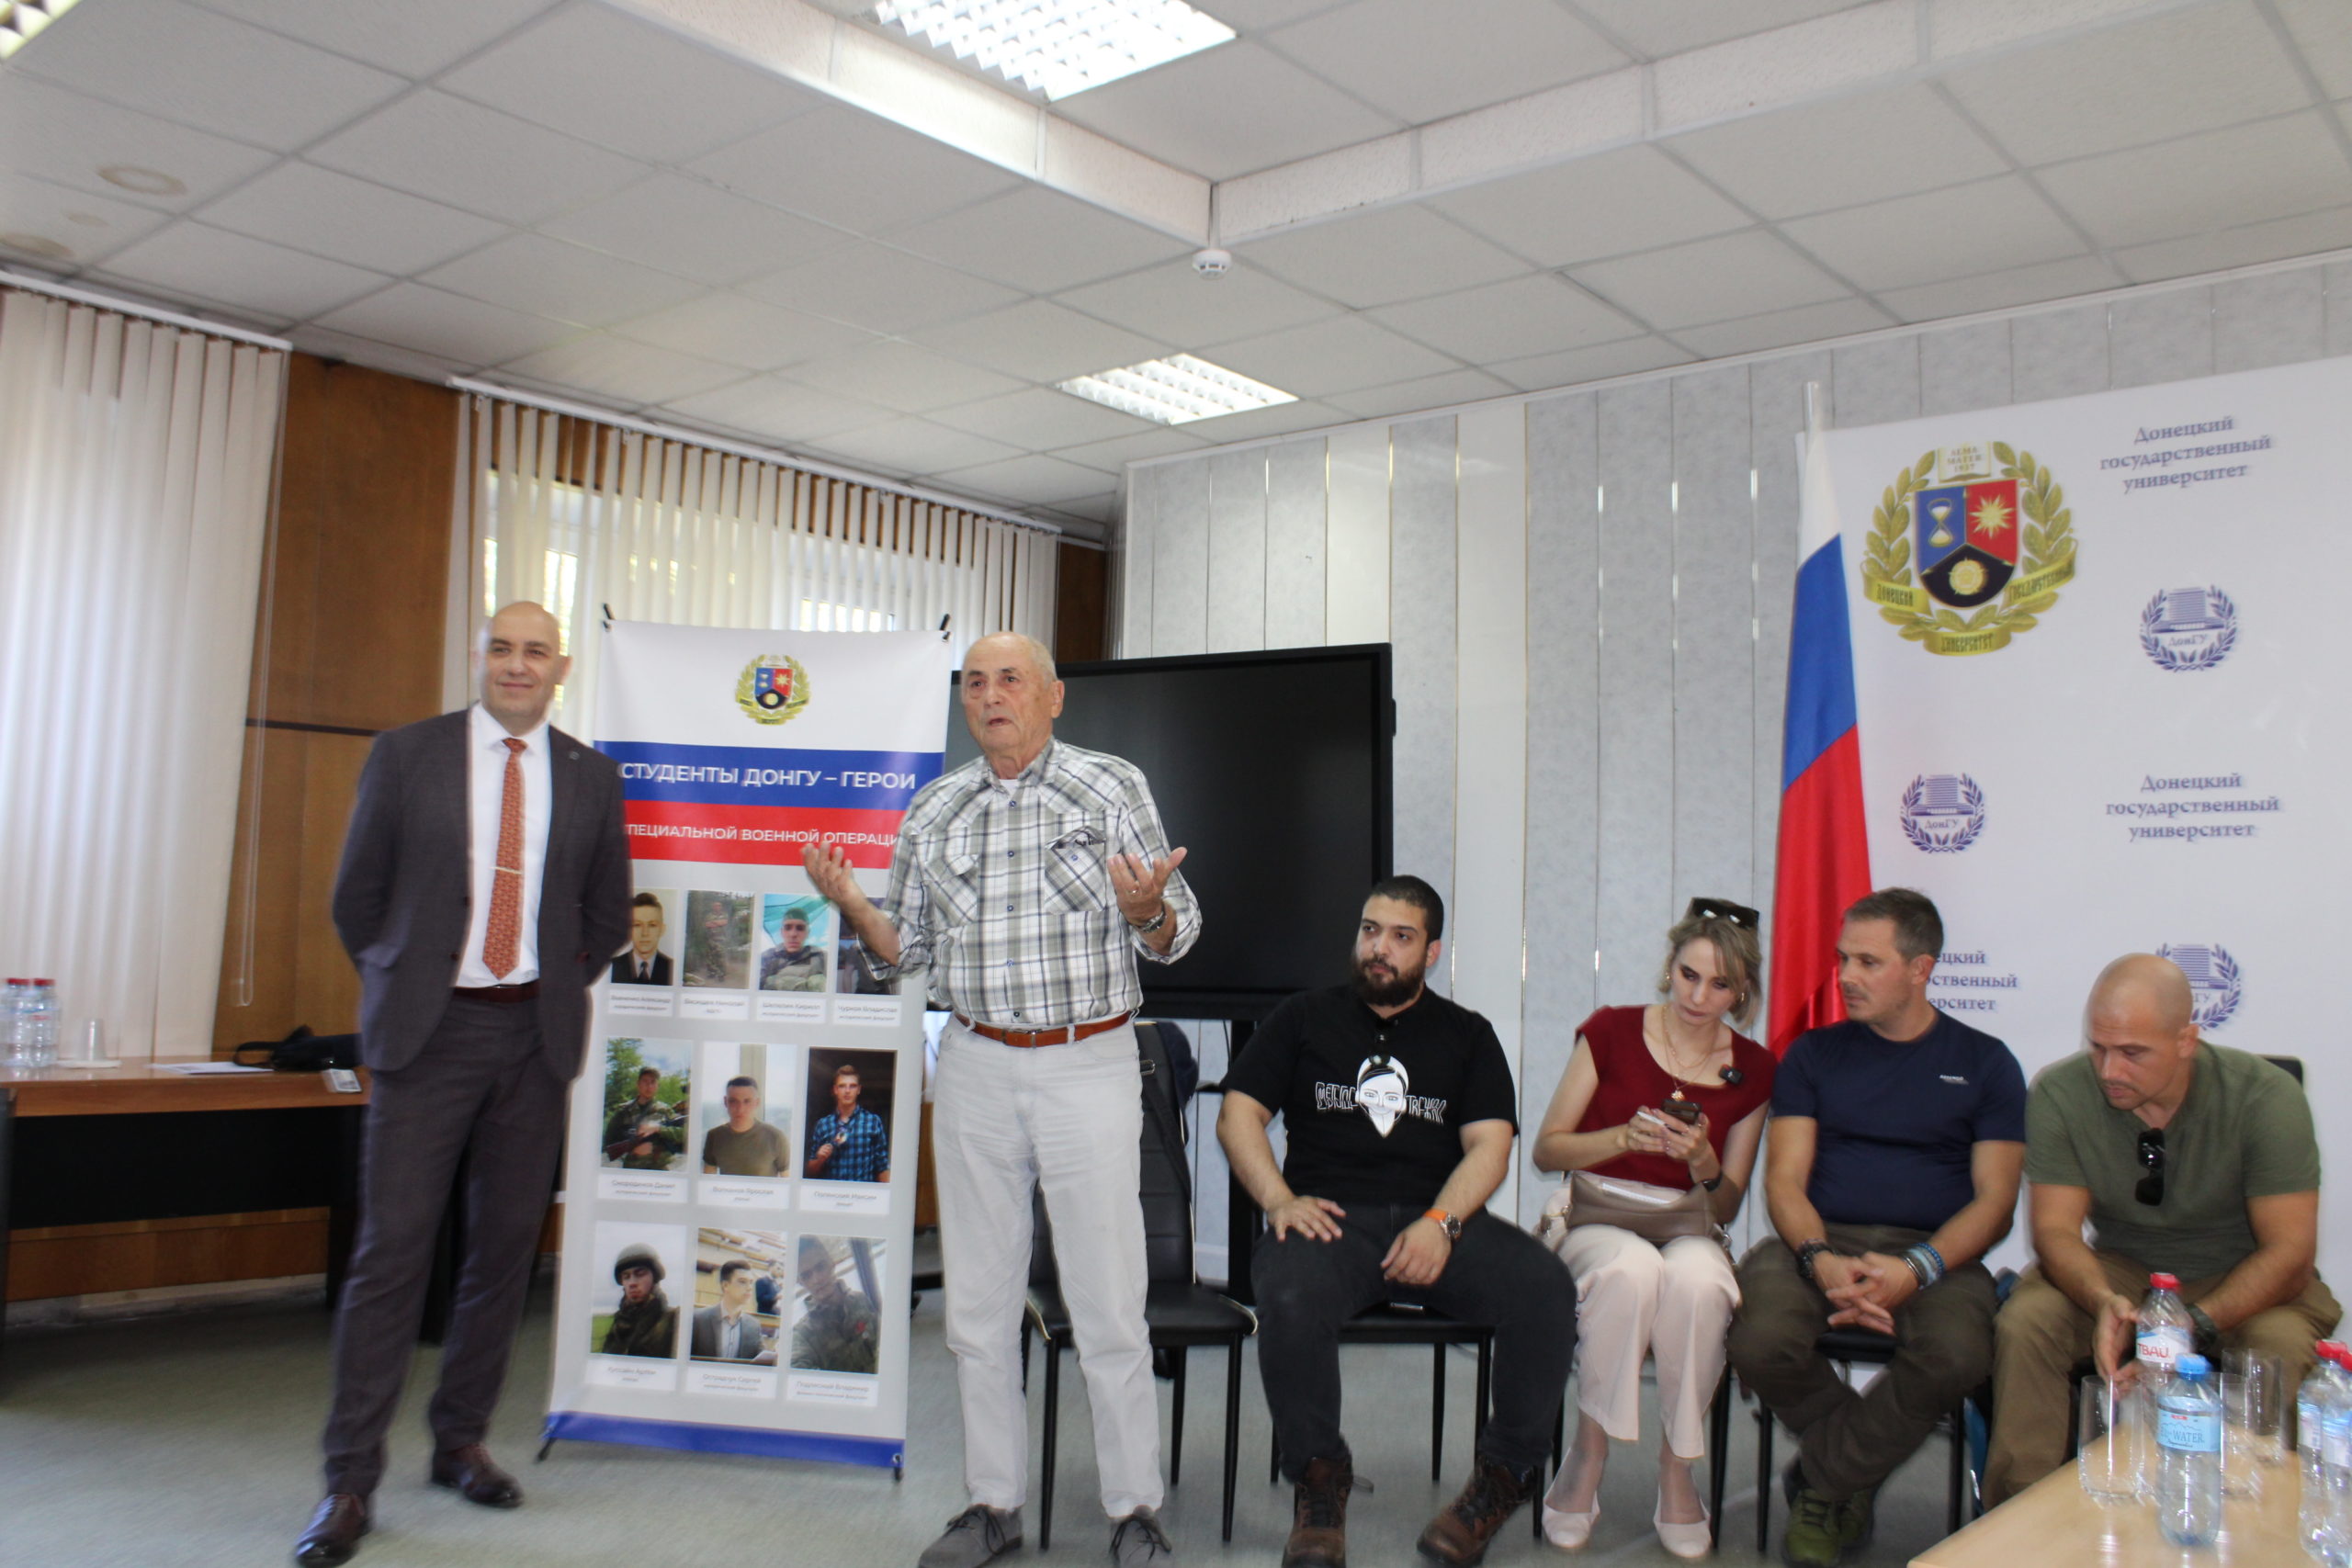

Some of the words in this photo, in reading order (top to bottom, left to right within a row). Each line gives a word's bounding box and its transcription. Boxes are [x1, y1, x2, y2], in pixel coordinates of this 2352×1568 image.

[2133, 416, 2235, 445] Донецкий
[2099, 434, 2273, 471] государственный
[2121, 464, 2248, 495] университет
[617, 761, 739, 784] СТУДЕНТЫ
[741, 767, 822, 787] ДОНГУ
[840, 770, 916, 789] ГЕРОИ
[2140, 773, 2243, 794] Донецкий
[2105, 796, 2280, 818] государственный
[1924, 818, 1959, 829] ДонГУ
[2128, 824, 2256, 843] университет
[626, 824, 738, 840] ПЕЦИАЛЬНОЙ
[741, 829, 820, 843] ВОЕННОЙ
[823, 831, 898, 847] ОПЕРАЦИ
[1937, 950, 1986, 965] цкий
[1928, 973, 2018, 987] ственный
[1928, 997, 1996, 1010] ерситет
